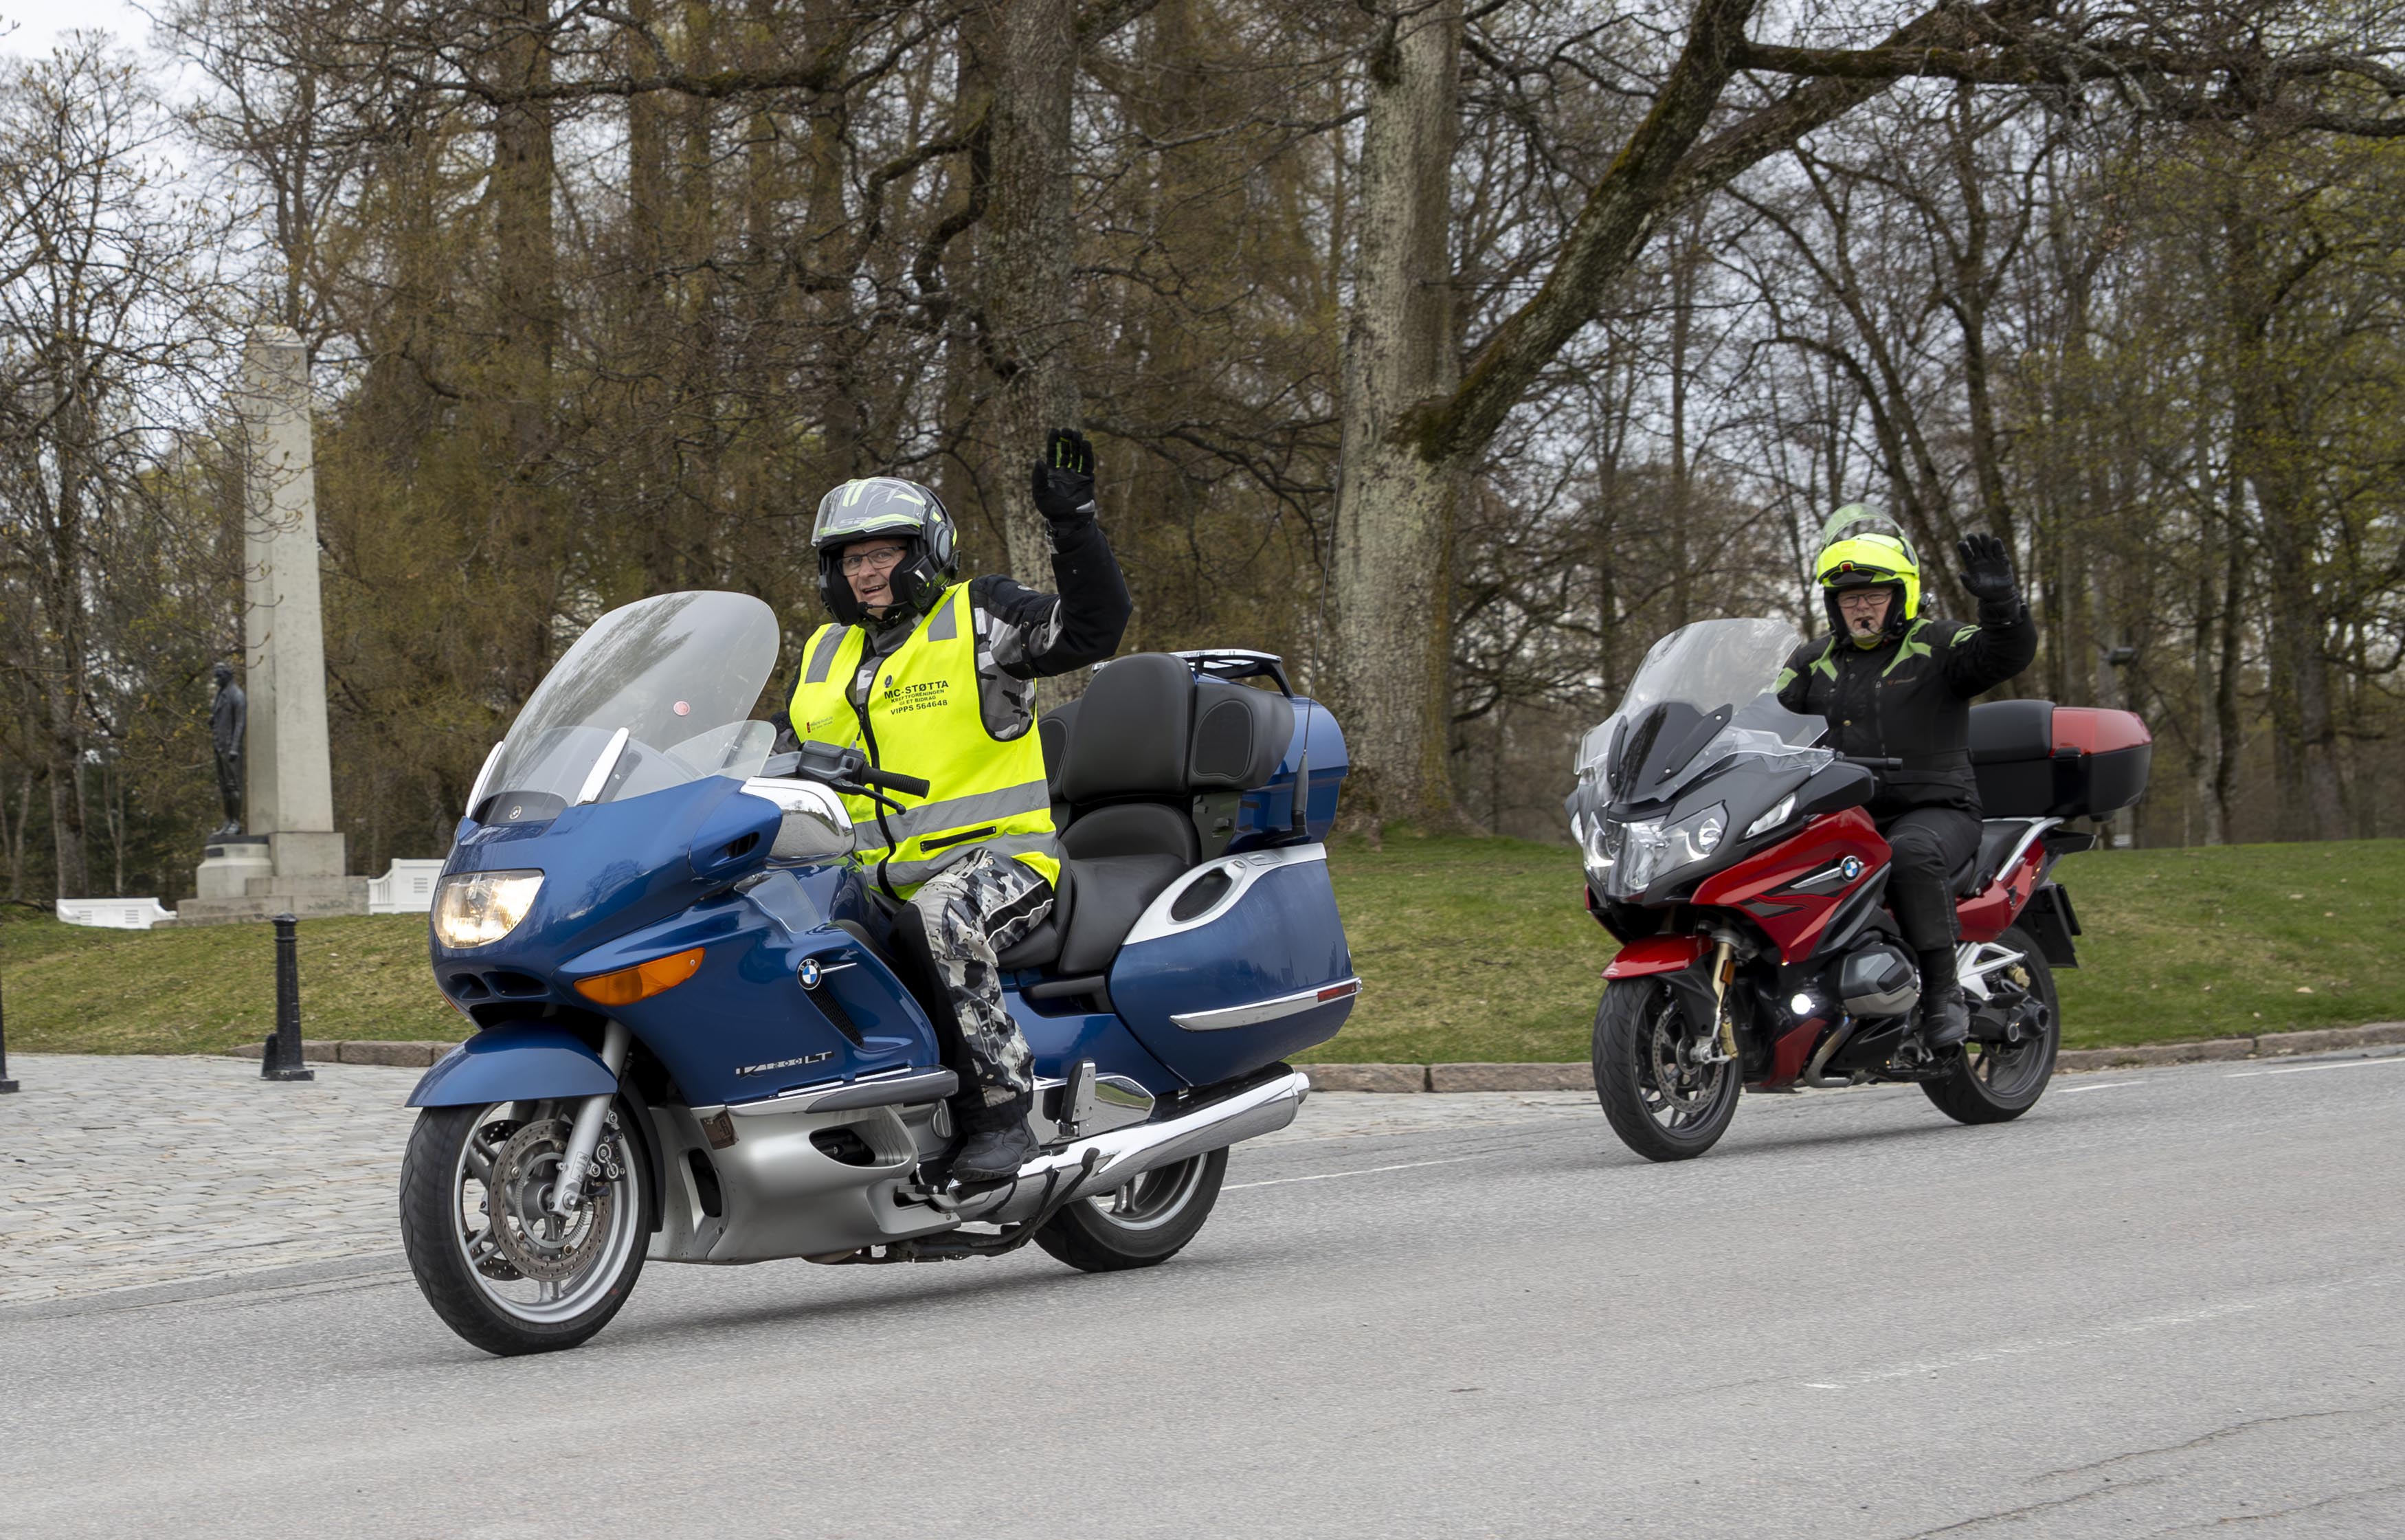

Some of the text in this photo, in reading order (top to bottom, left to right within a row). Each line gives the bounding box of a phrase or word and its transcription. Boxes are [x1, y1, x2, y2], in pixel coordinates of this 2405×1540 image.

[884, 680, 949, 700] MC-STØTTA
[891, 689, 945, 703] KREFTFORENINGEN
[891, 700, 948, 715] VIPPS 564648
